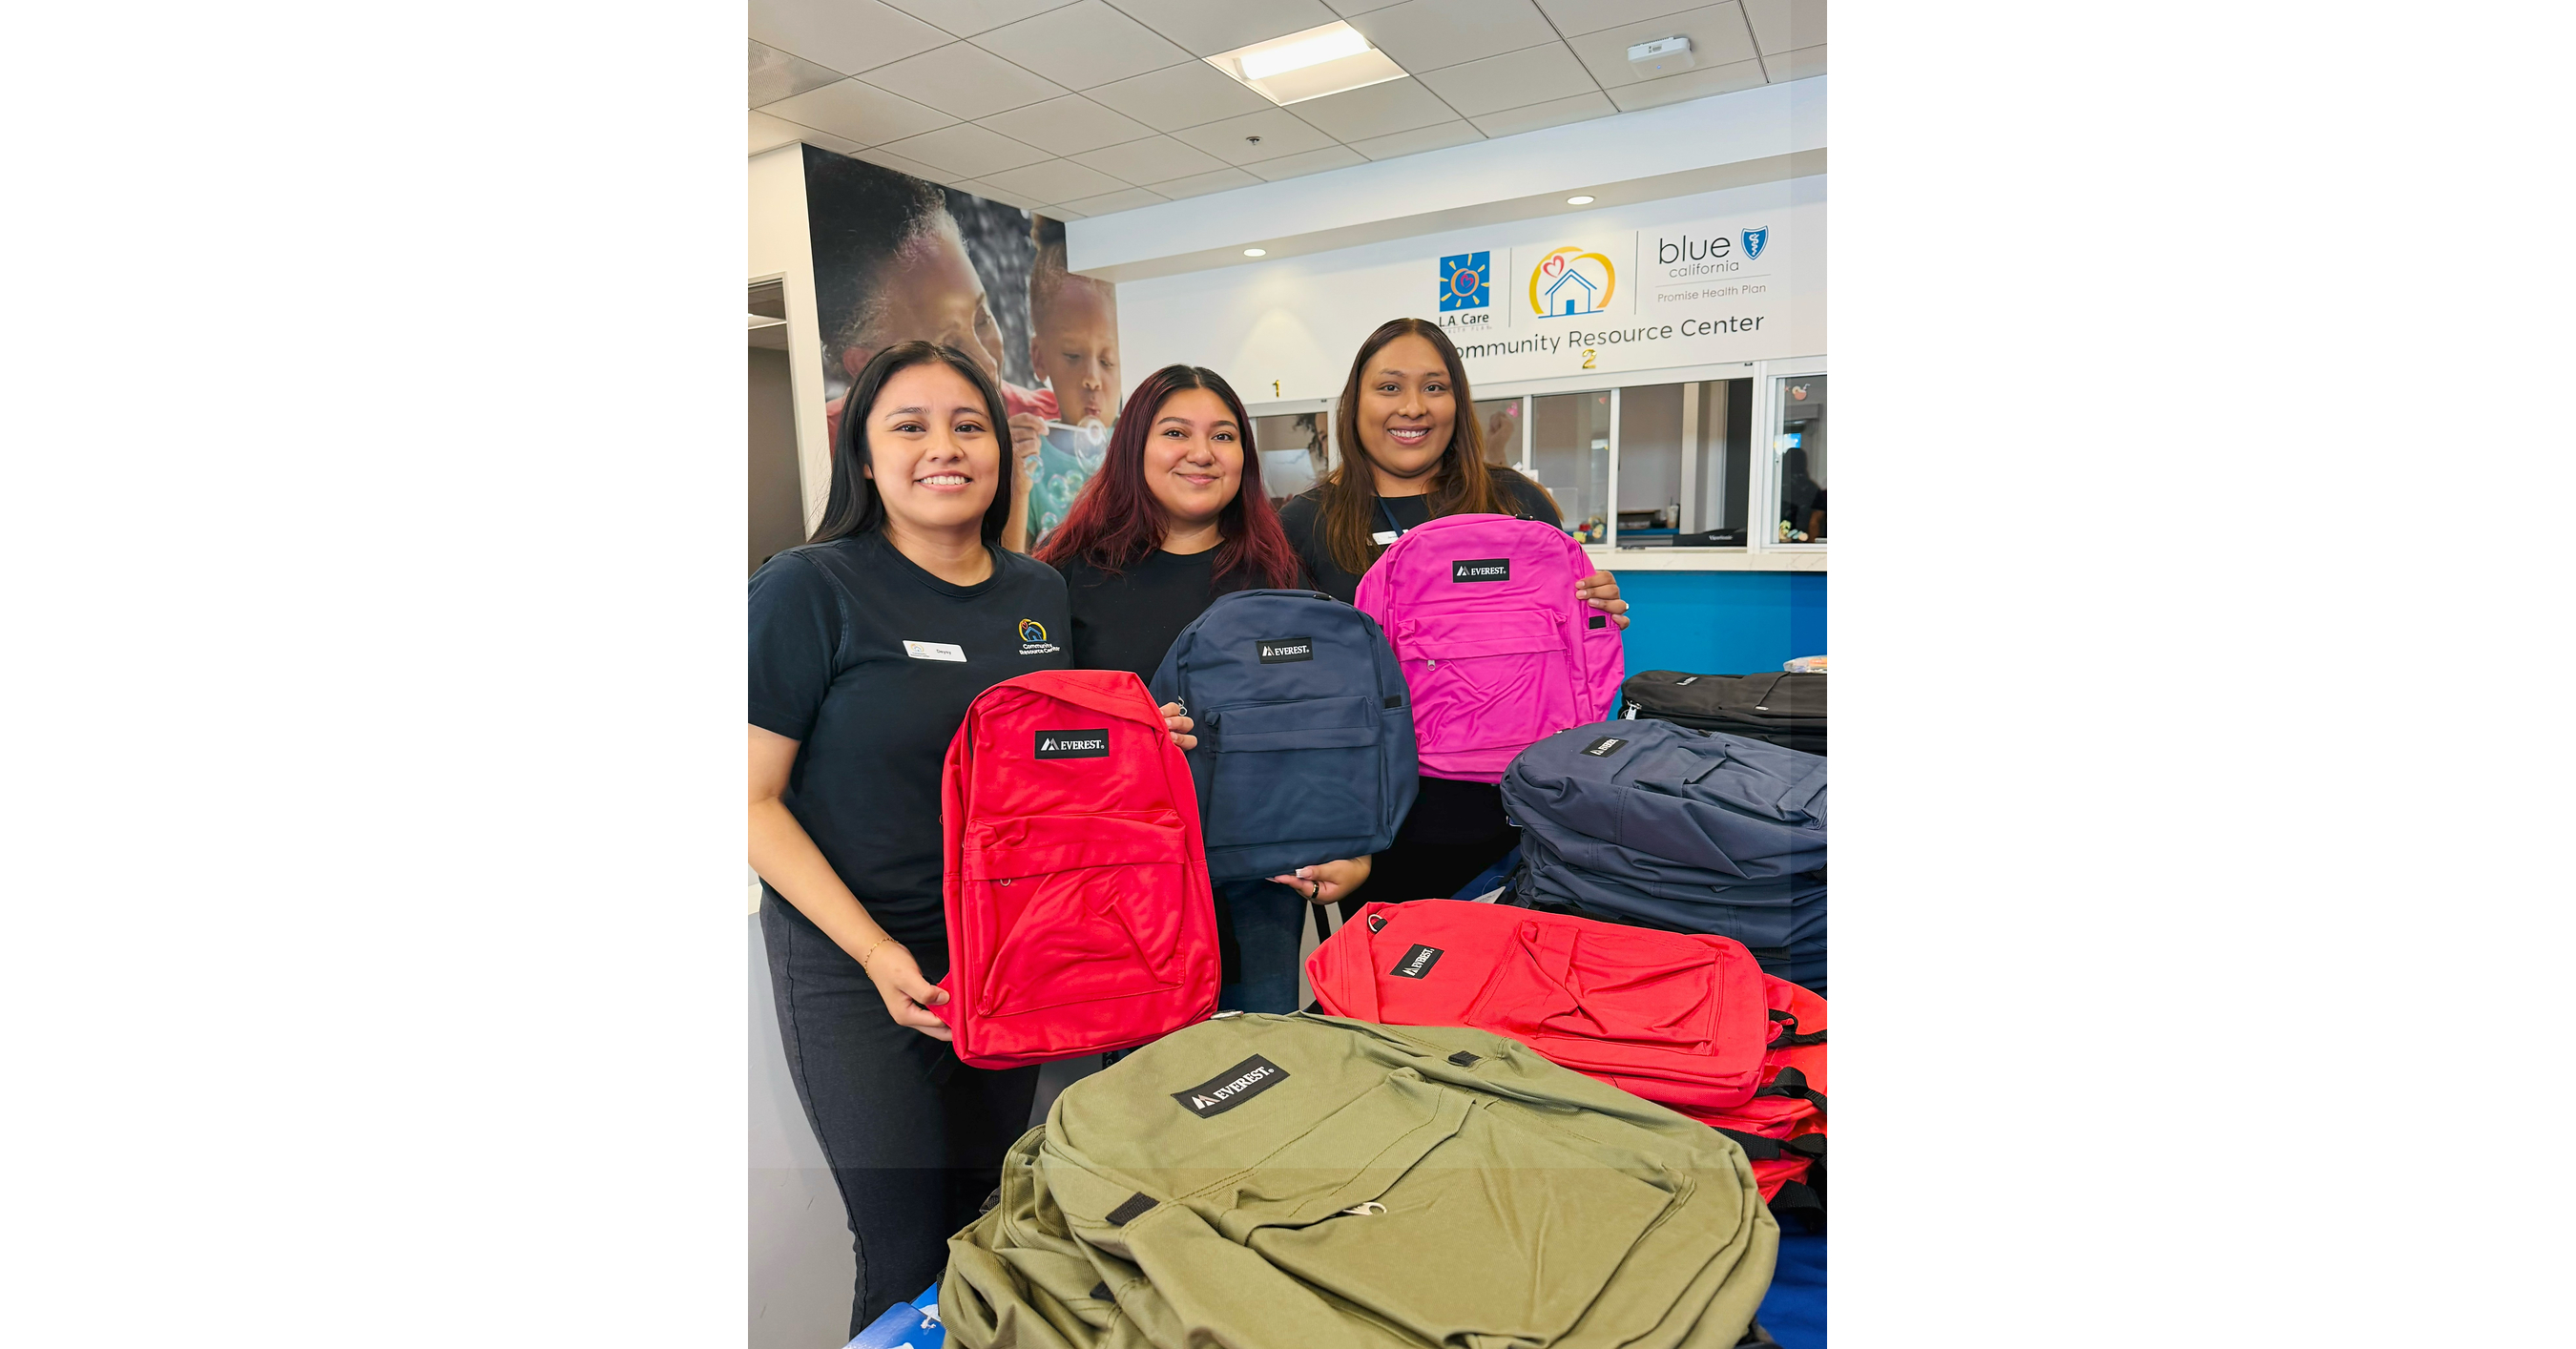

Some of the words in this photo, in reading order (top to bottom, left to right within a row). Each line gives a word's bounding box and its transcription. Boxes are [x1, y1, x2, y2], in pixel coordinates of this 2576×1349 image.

[1659, 235, 1731, 264] blue
[1669, 259, 1739, 278] california
[1657, 290, 1699, 302] Promise
[1702, 286, 1738, 299] Health
[1741, 283, 1767, 295] Plan
[1462, 313, 1489, 325] Care
[1457, 334, 1561, 360] ommunity
[1568, 325, 1672, 348] Resource
[1681, 316, 1764, 337] Center
[1582, 348, 1597, 369] 2
[1272, 380, 1279, 398] 1
